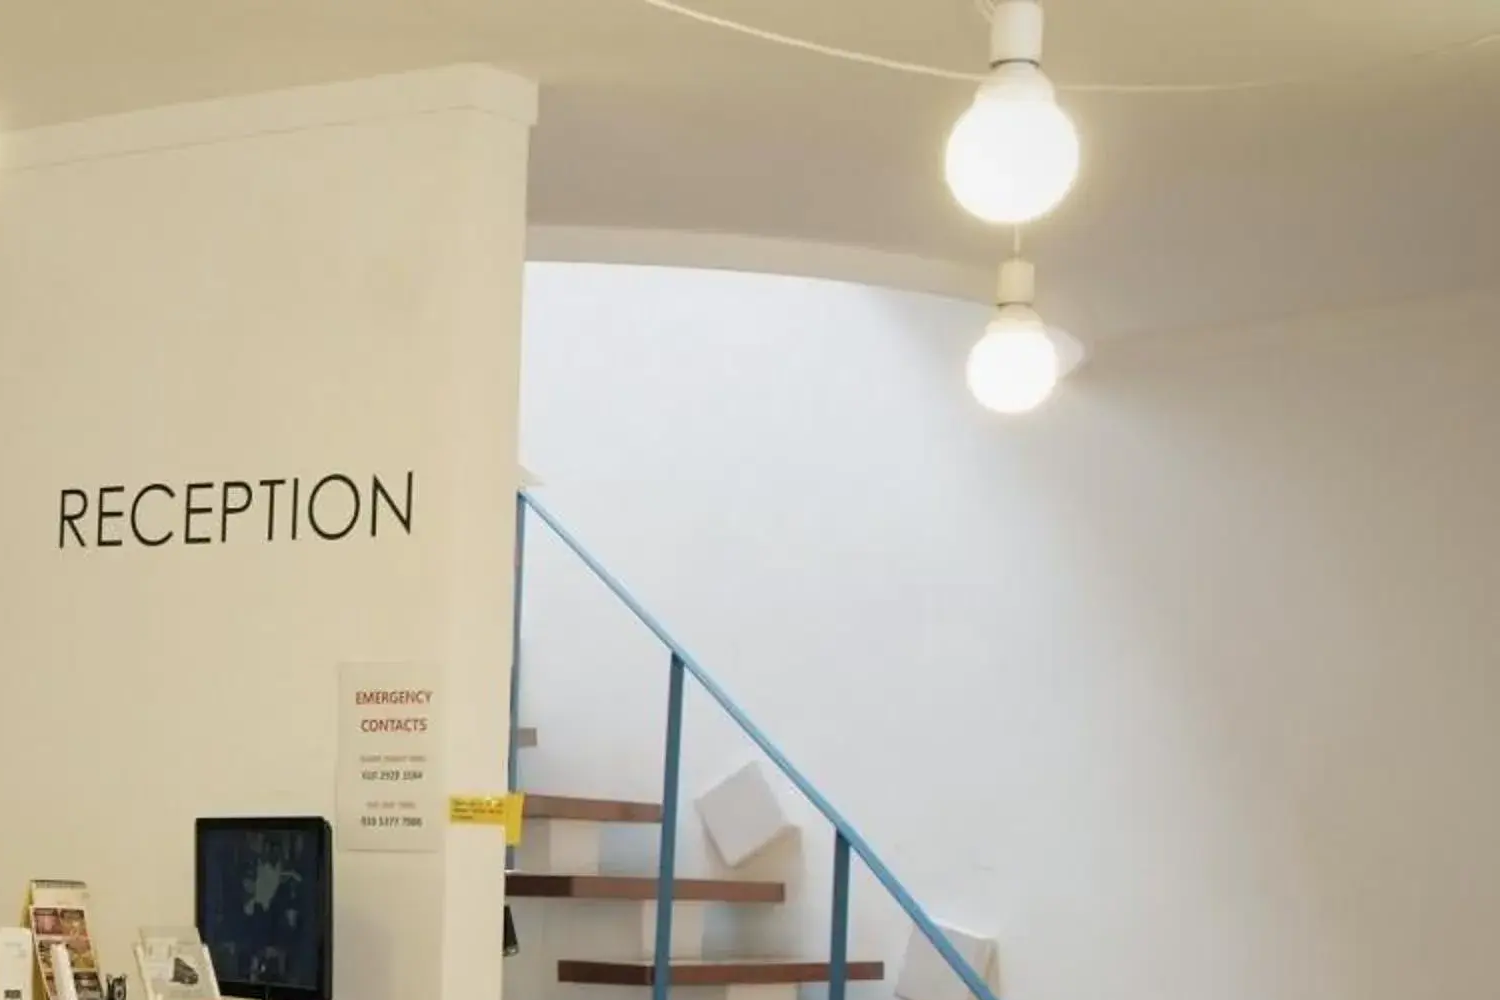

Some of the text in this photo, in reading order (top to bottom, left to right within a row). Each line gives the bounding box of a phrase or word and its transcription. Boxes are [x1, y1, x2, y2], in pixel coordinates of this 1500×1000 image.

[59, 471, 414, 548] RECEPTION
[355, 690, 433, 705] EMERGENCY
[361, 718, 428, 732] CONTACTS
